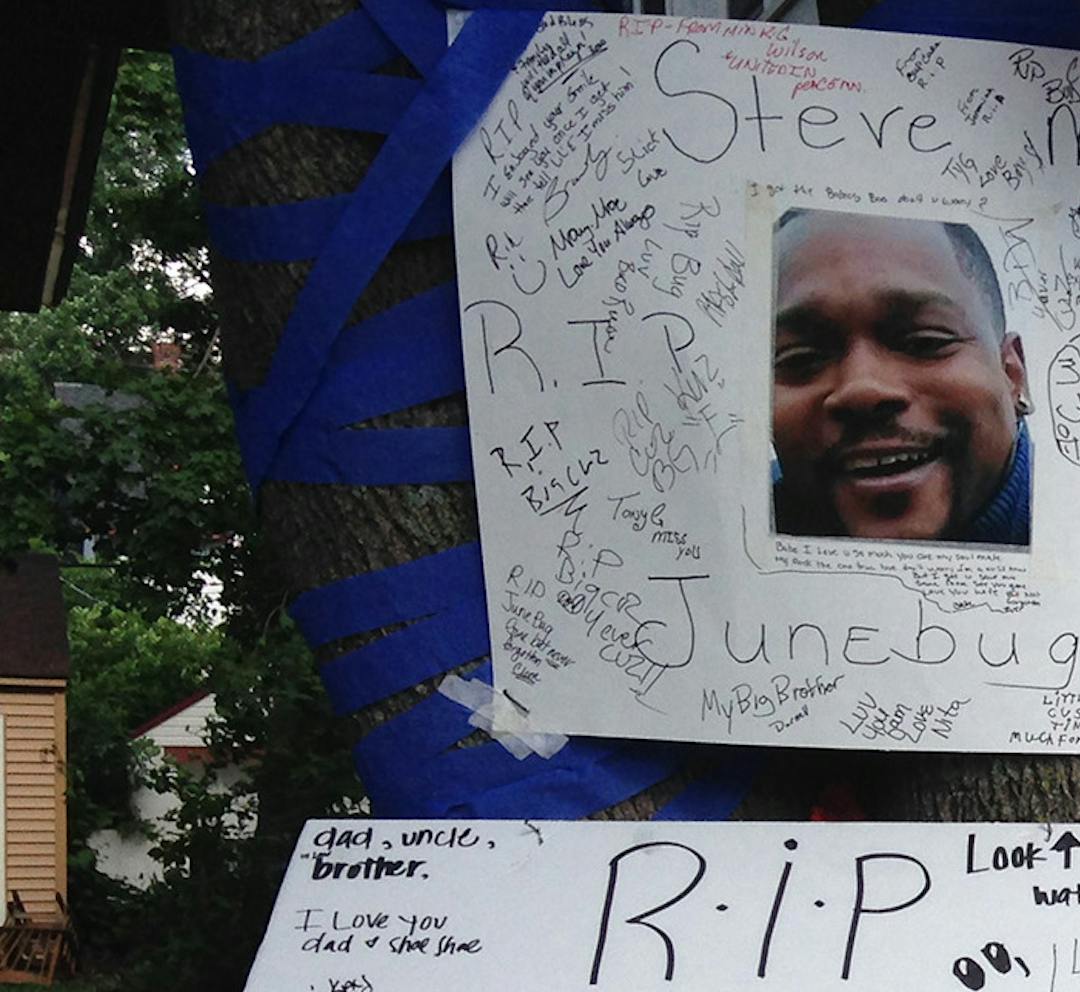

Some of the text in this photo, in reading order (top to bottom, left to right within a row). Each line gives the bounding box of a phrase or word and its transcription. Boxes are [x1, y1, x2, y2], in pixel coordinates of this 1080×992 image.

[653, 38, 953, 164] Steve
[966, 833, 1048, 874] Look
[294, 908, 324, 931] I
[300, 933, 352, 954] dad
